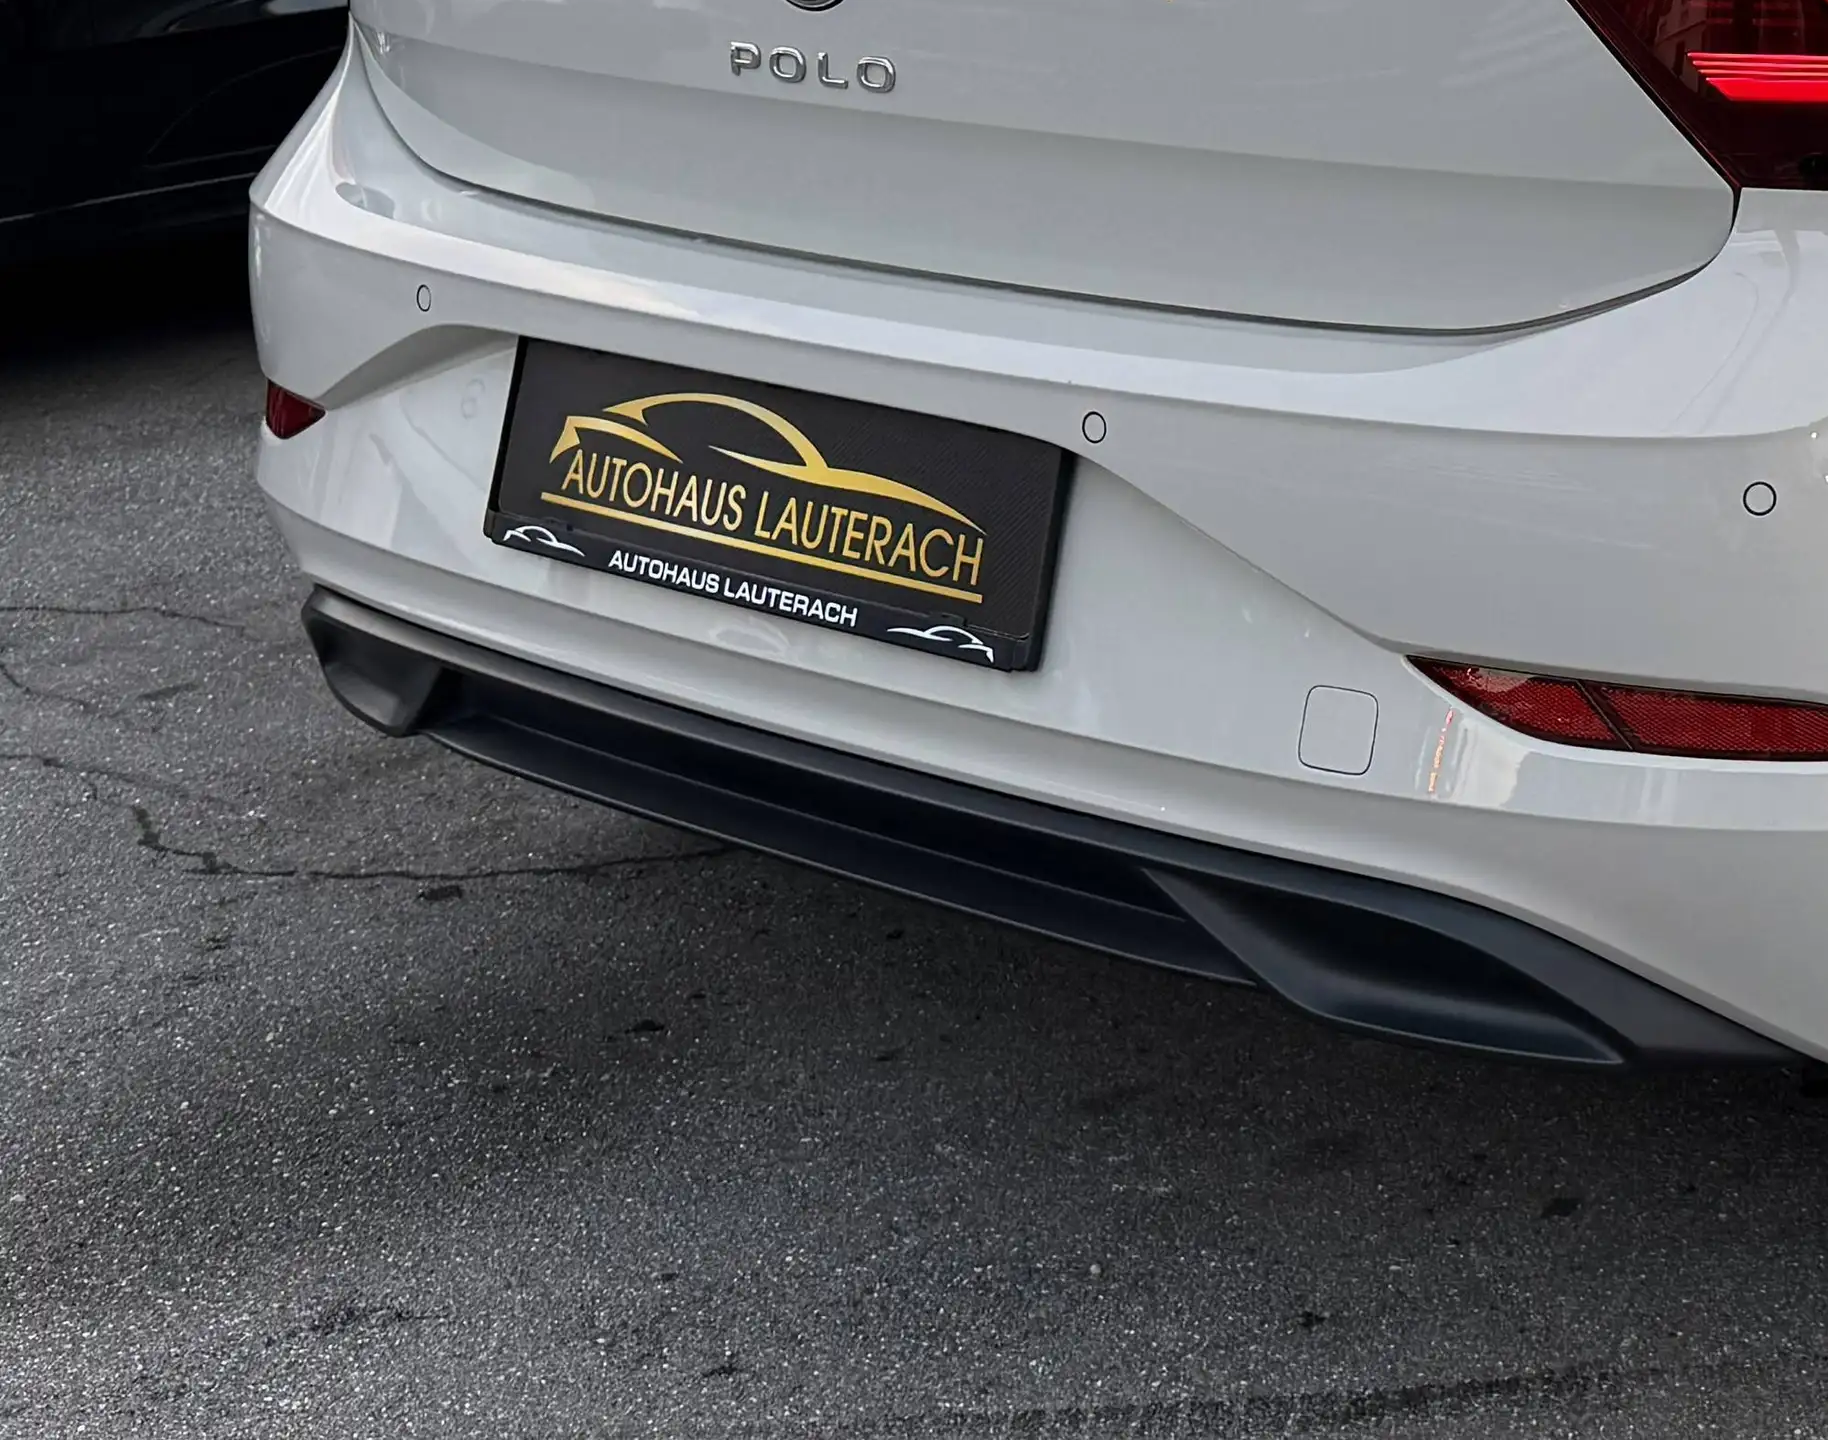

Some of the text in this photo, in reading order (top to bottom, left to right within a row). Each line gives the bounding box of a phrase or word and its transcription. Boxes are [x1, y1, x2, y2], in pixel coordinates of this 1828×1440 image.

[730, 41, 897, 94] POLO
[561, 449, 985, 587] AUTOHAUS LAUTERACH
[608, 549, 858, 628] AUTOHAUS LAUTERACH
